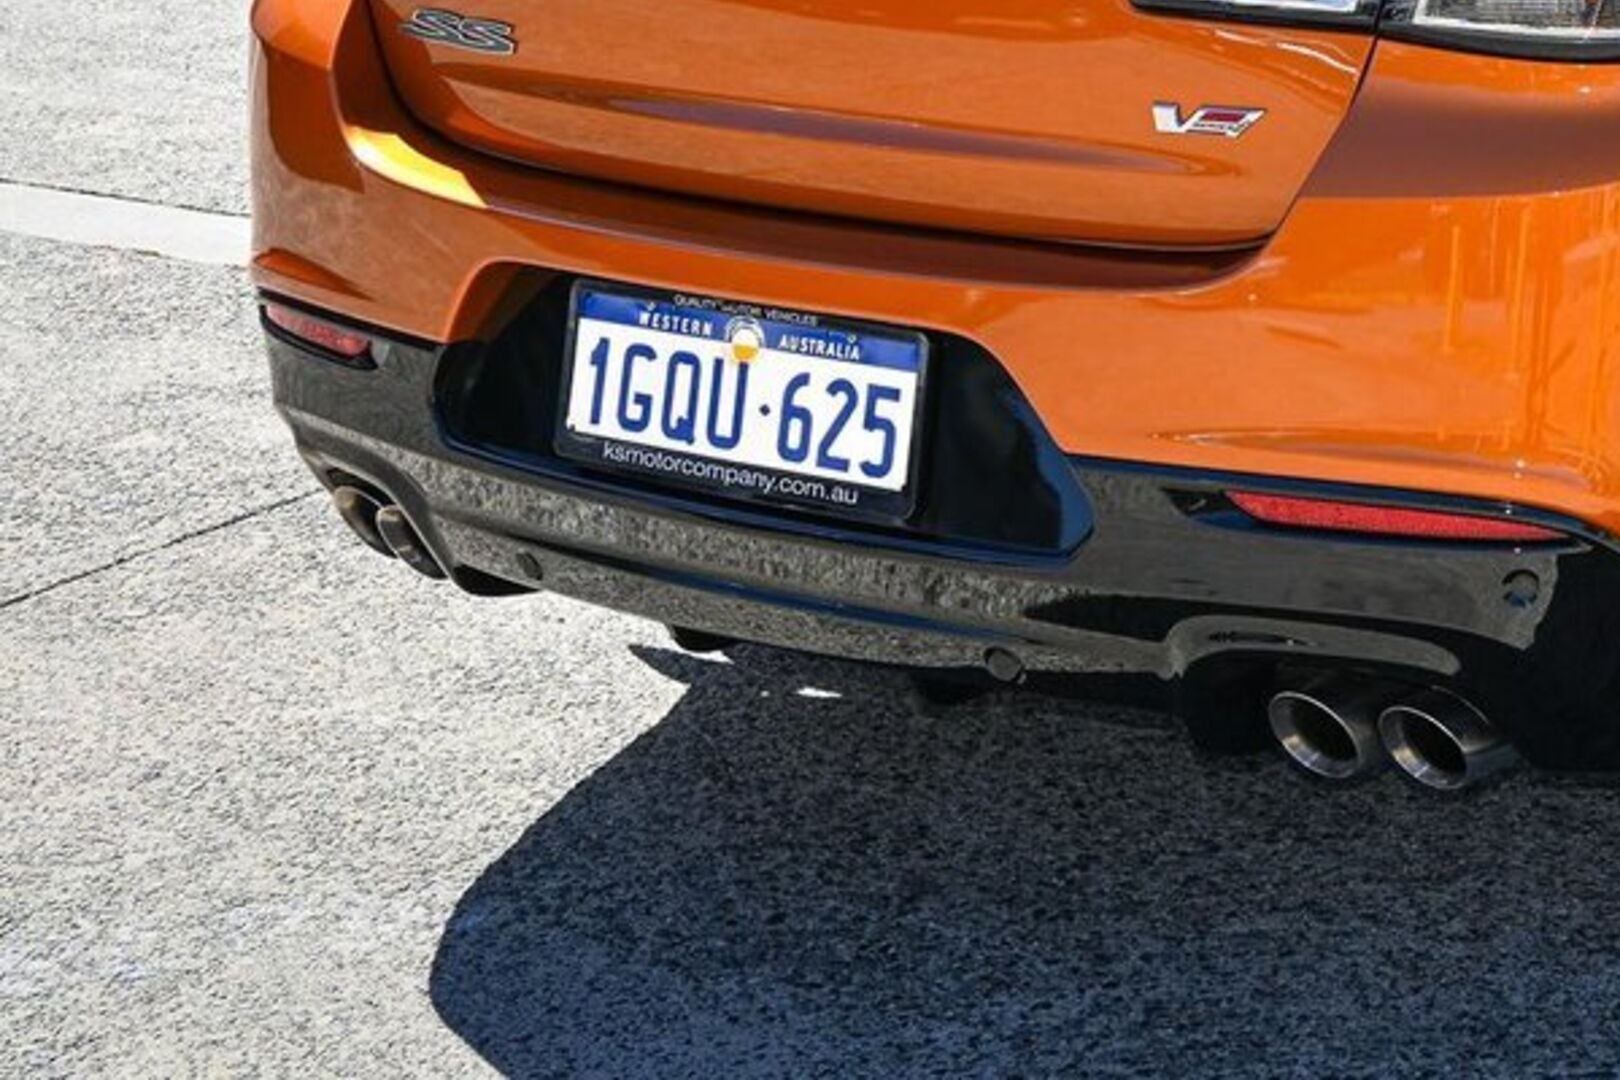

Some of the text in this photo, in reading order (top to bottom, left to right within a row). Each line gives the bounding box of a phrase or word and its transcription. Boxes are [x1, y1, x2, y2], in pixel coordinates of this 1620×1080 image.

[638, 310, 861, 361] WESTERN AUSTRALIA
[602, 440, 859, 506] ksmotorcompany.com.au
